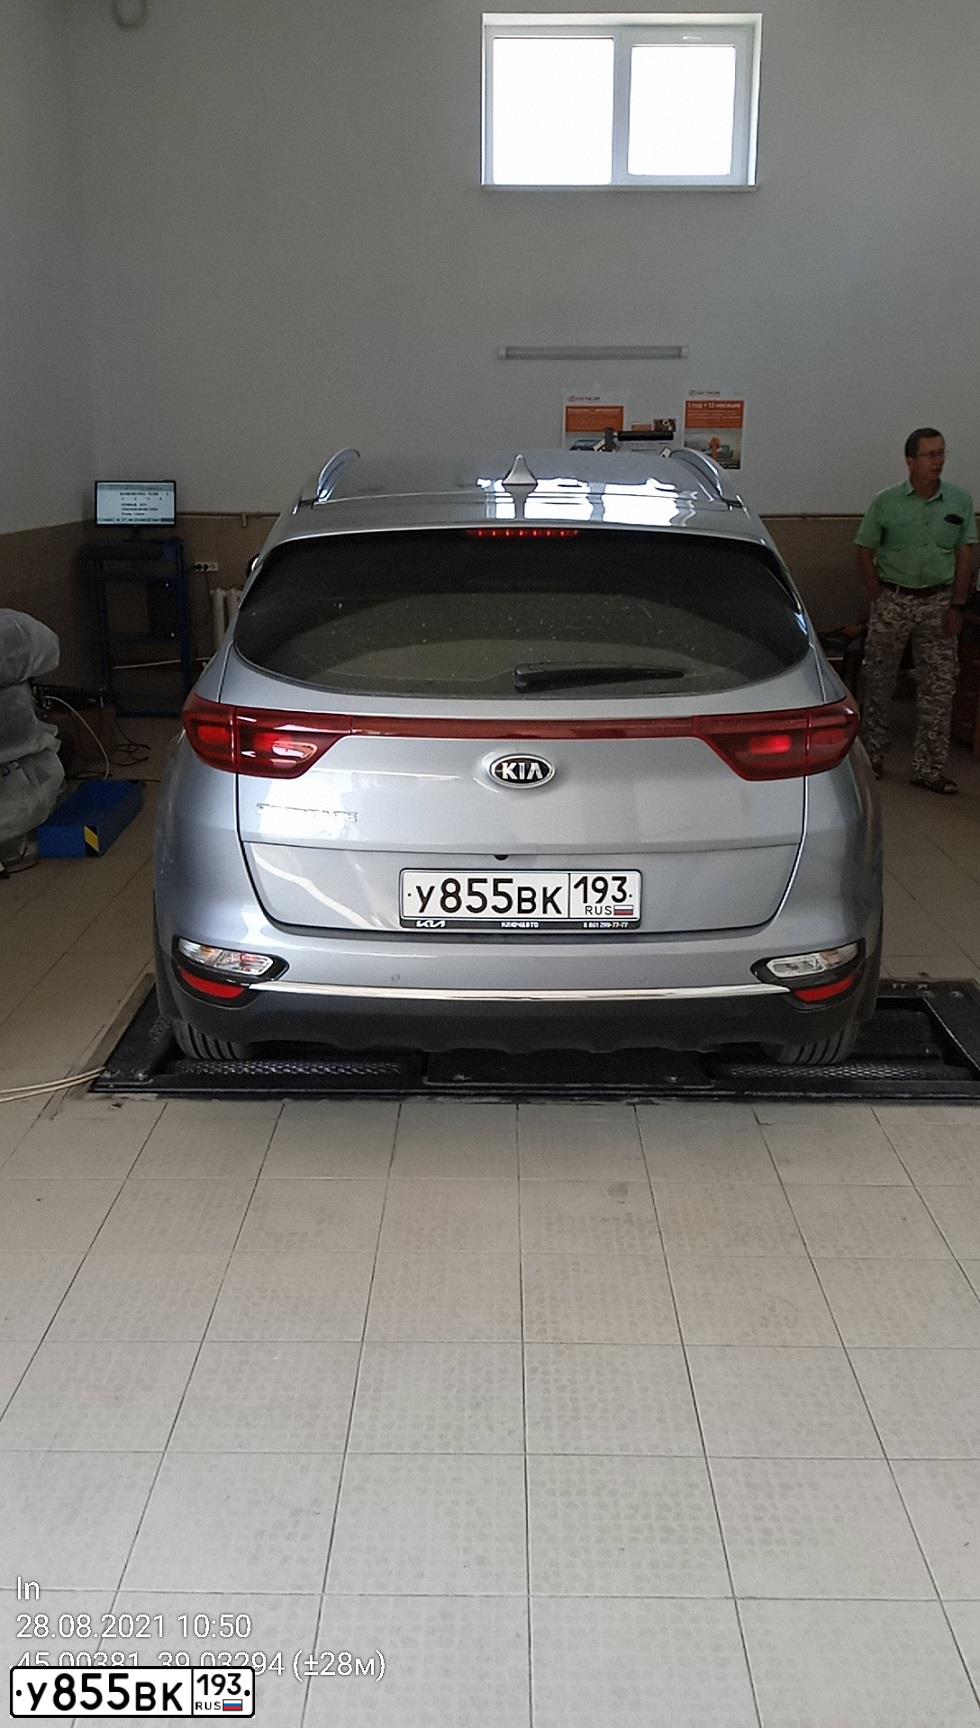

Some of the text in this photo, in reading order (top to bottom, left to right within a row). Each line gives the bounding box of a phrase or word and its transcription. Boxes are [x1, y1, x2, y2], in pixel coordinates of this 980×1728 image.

[501, 762, 543, 780] KIA
[573, 876, 628, 904] 193
[584, 905, 612, 915] RUS
